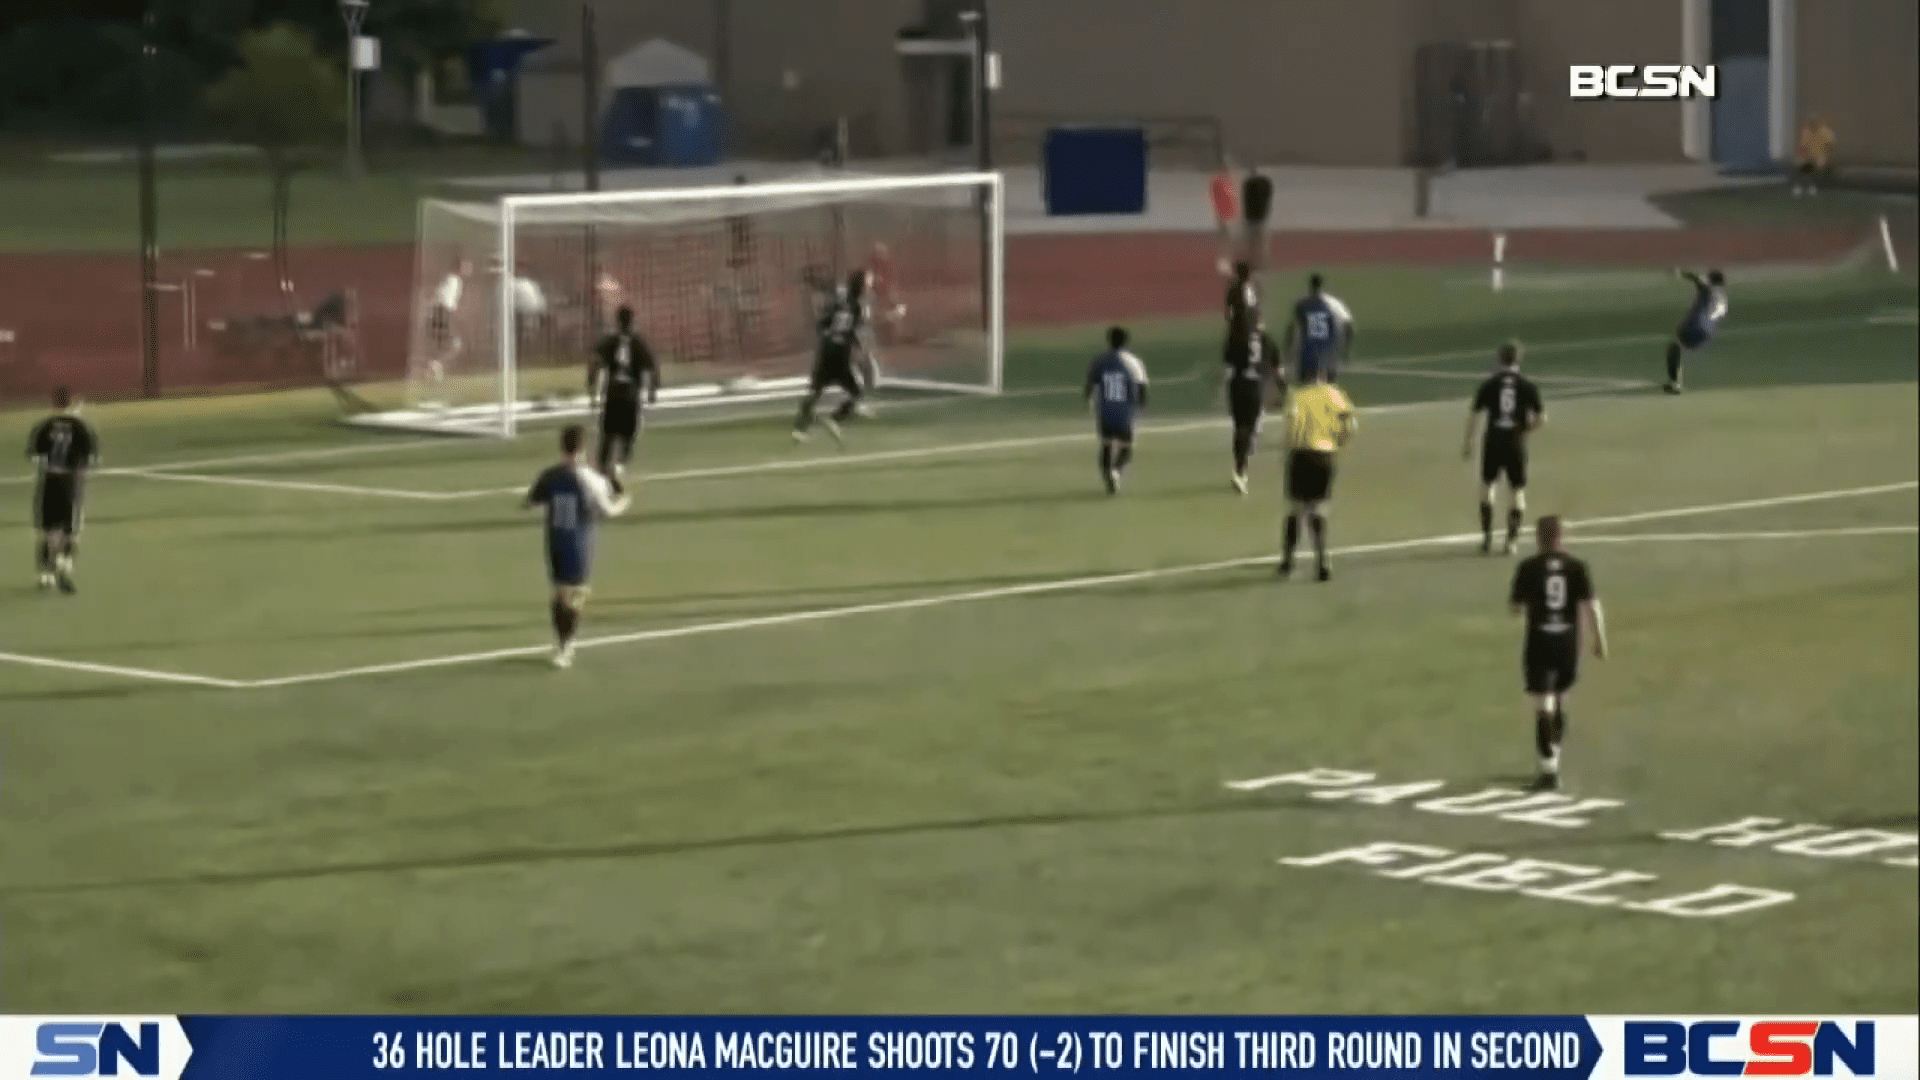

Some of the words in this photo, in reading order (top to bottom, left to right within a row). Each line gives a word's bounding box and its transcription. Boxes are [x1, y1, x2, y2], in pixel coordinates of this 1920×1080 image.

[1545, 575, 1568, 611] 9
[1222, 766, 1624, 829] PAUL
[1276, 841, 1796, 918] FIELD
